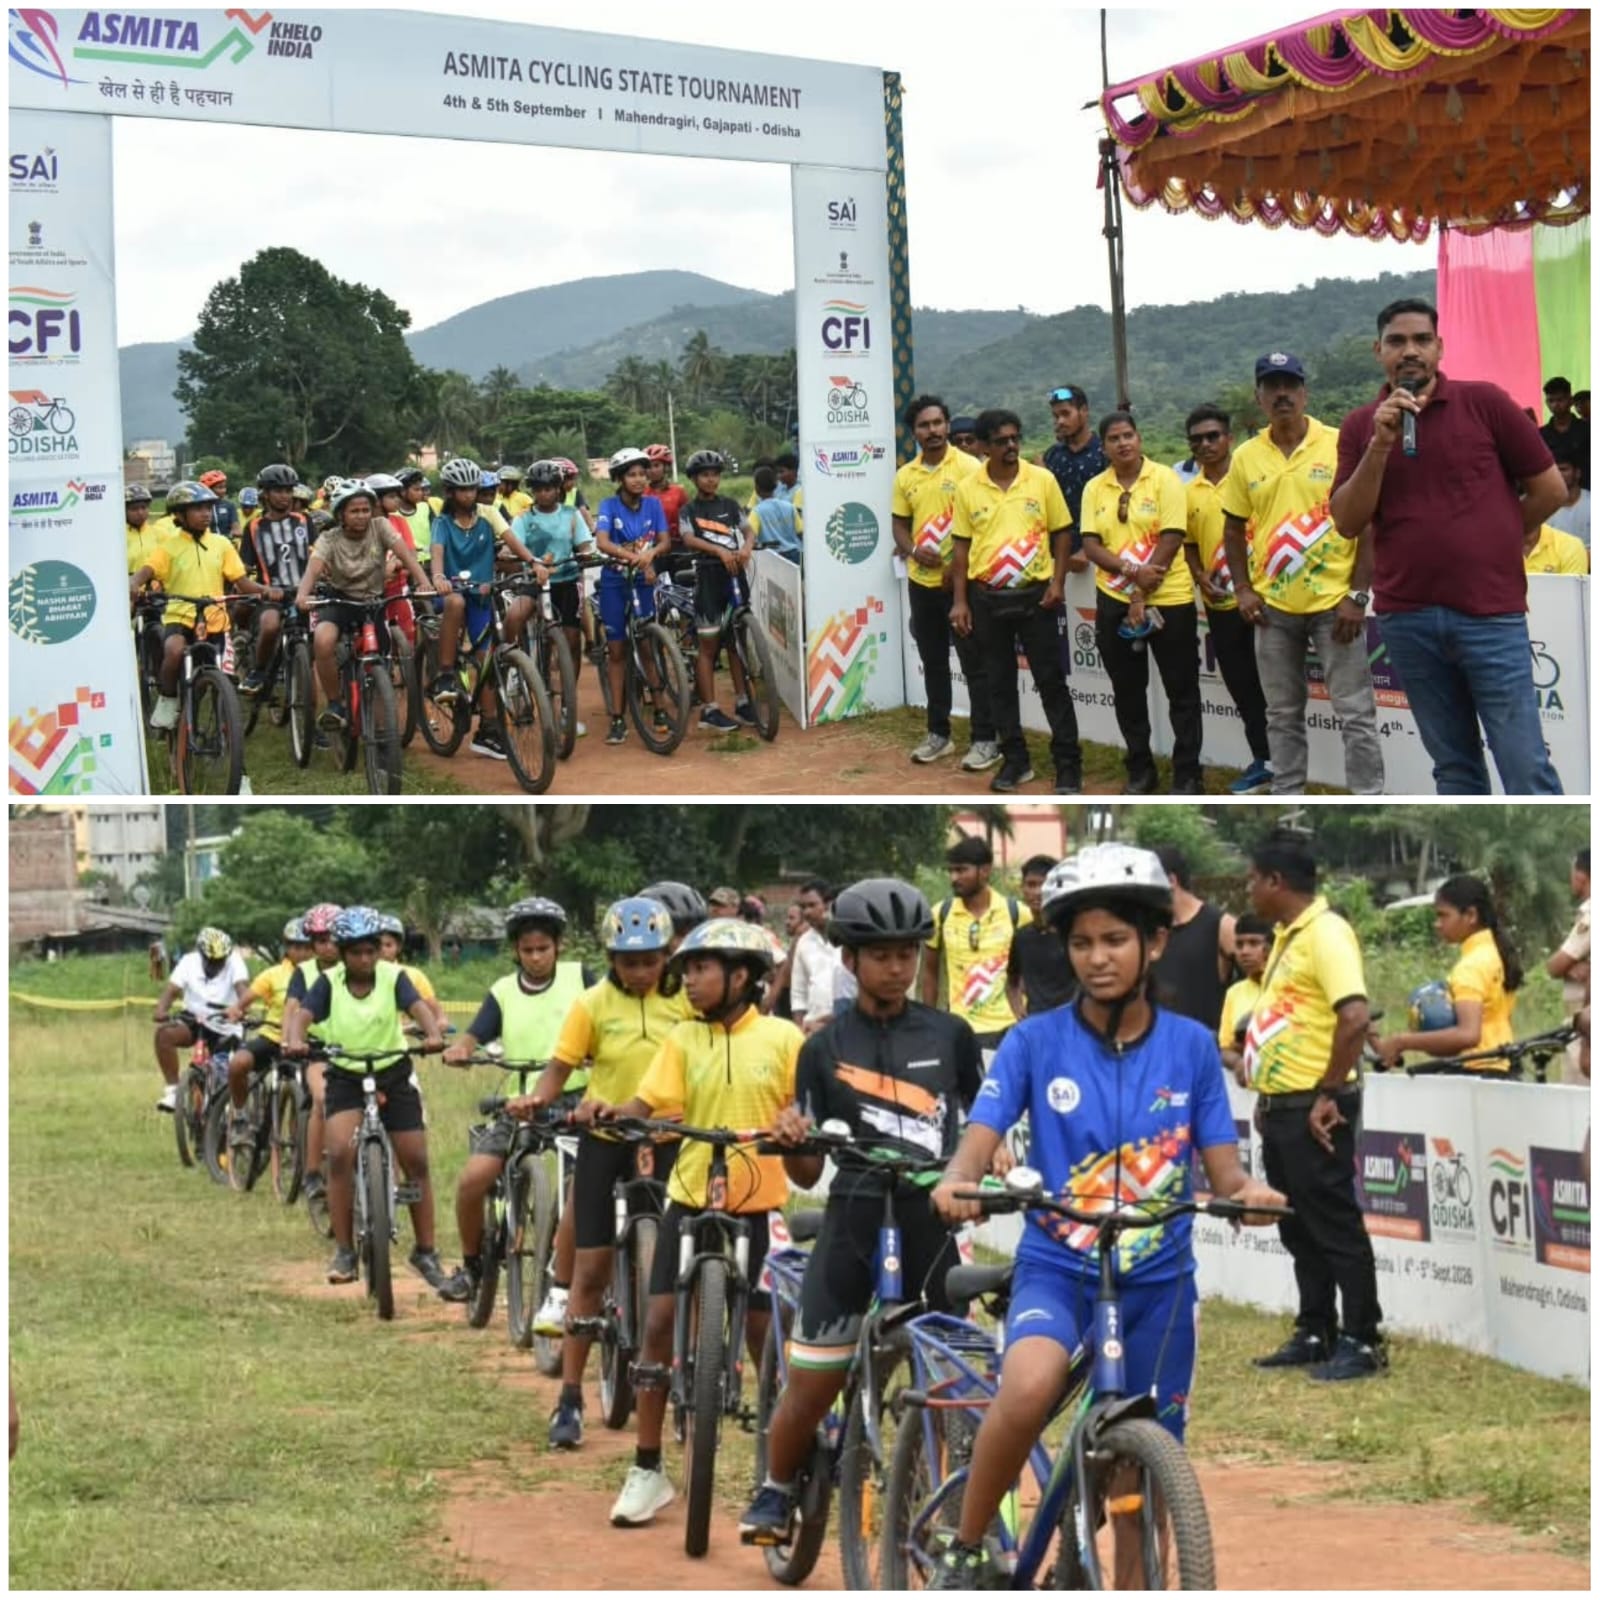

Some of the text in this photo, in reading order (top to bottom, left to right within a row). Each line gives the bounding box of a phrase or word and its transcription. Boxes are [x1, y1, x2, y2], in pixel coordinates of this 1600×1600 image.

[78, 11, 199, 51] ASMITA
[270, 22, 322, 42] KHELO
[268, 39, 312, 59] INDIA
[443, 51, 802, 109] ASMITA CYCLING STATE TOURNAMENT
[98, 76, 233, 107] खेल से ही है पहचान
[443, 94, 467, 109] 4th
[471, 96, 482, 110] &
[486, 97, 509, 113] 5th
[513, 100, 586, 120] September
[614, 109, 700, 131] Mahendragiri,
[703, 118, 752, 135] Gajapati
[762, 123, 801, 138] Odisha
[9, 154, 57, 180] SAI
[828, 202, 856, 221] SAI
[9, 309, 80, 354] CFI
[821, 316, 870, 349] CFI
[827, 410, 869, 423] ODISHA
[9, 435, 79, 454] ODISHA
[832, 451, 858, 462] ASMITA
[13, 491, 58, 507] ASMITA
[281, 544, 291, 562] 2
[1071, 688, 1097, 706] Sept
[1380, 720, 1403, 738] 4th
[1432, 1204, 1475, 1229] ODISHA
[1490, 1178, 1531, 1240] CFI
